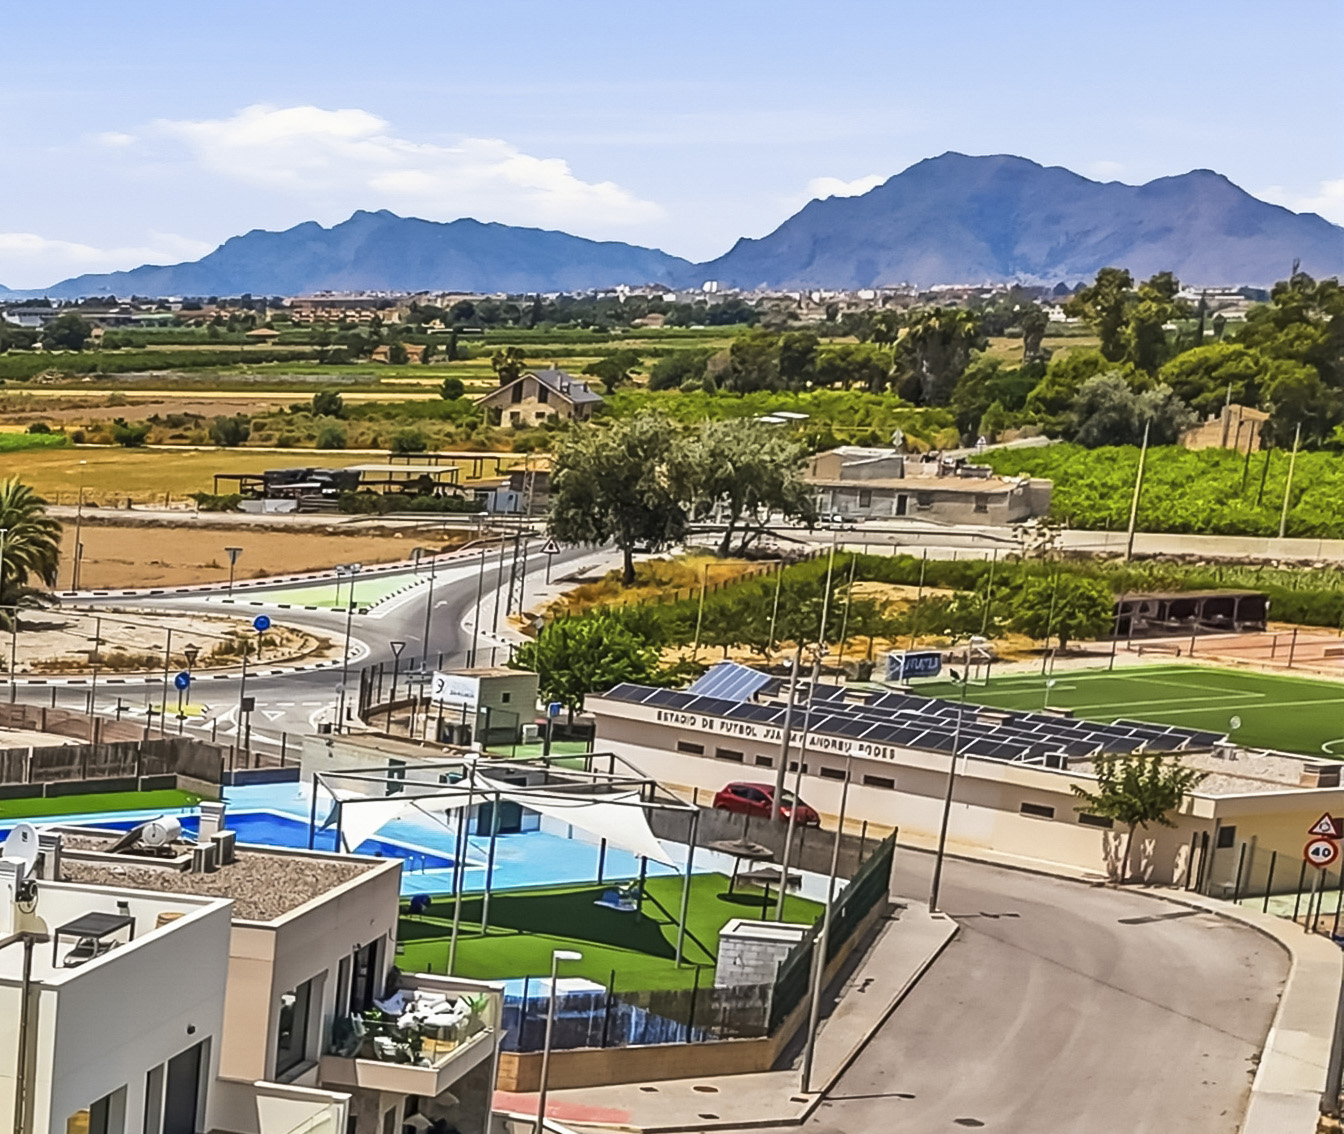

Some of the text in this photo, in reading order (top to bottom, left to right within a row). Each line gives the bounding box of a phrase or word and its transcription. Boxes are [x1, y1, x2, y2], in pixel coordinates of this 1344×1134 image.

[657, 710, 696, 726] ESTADIO
[702, 718, 714, 730] DE
[1311, 847, 1331, 858] 40
